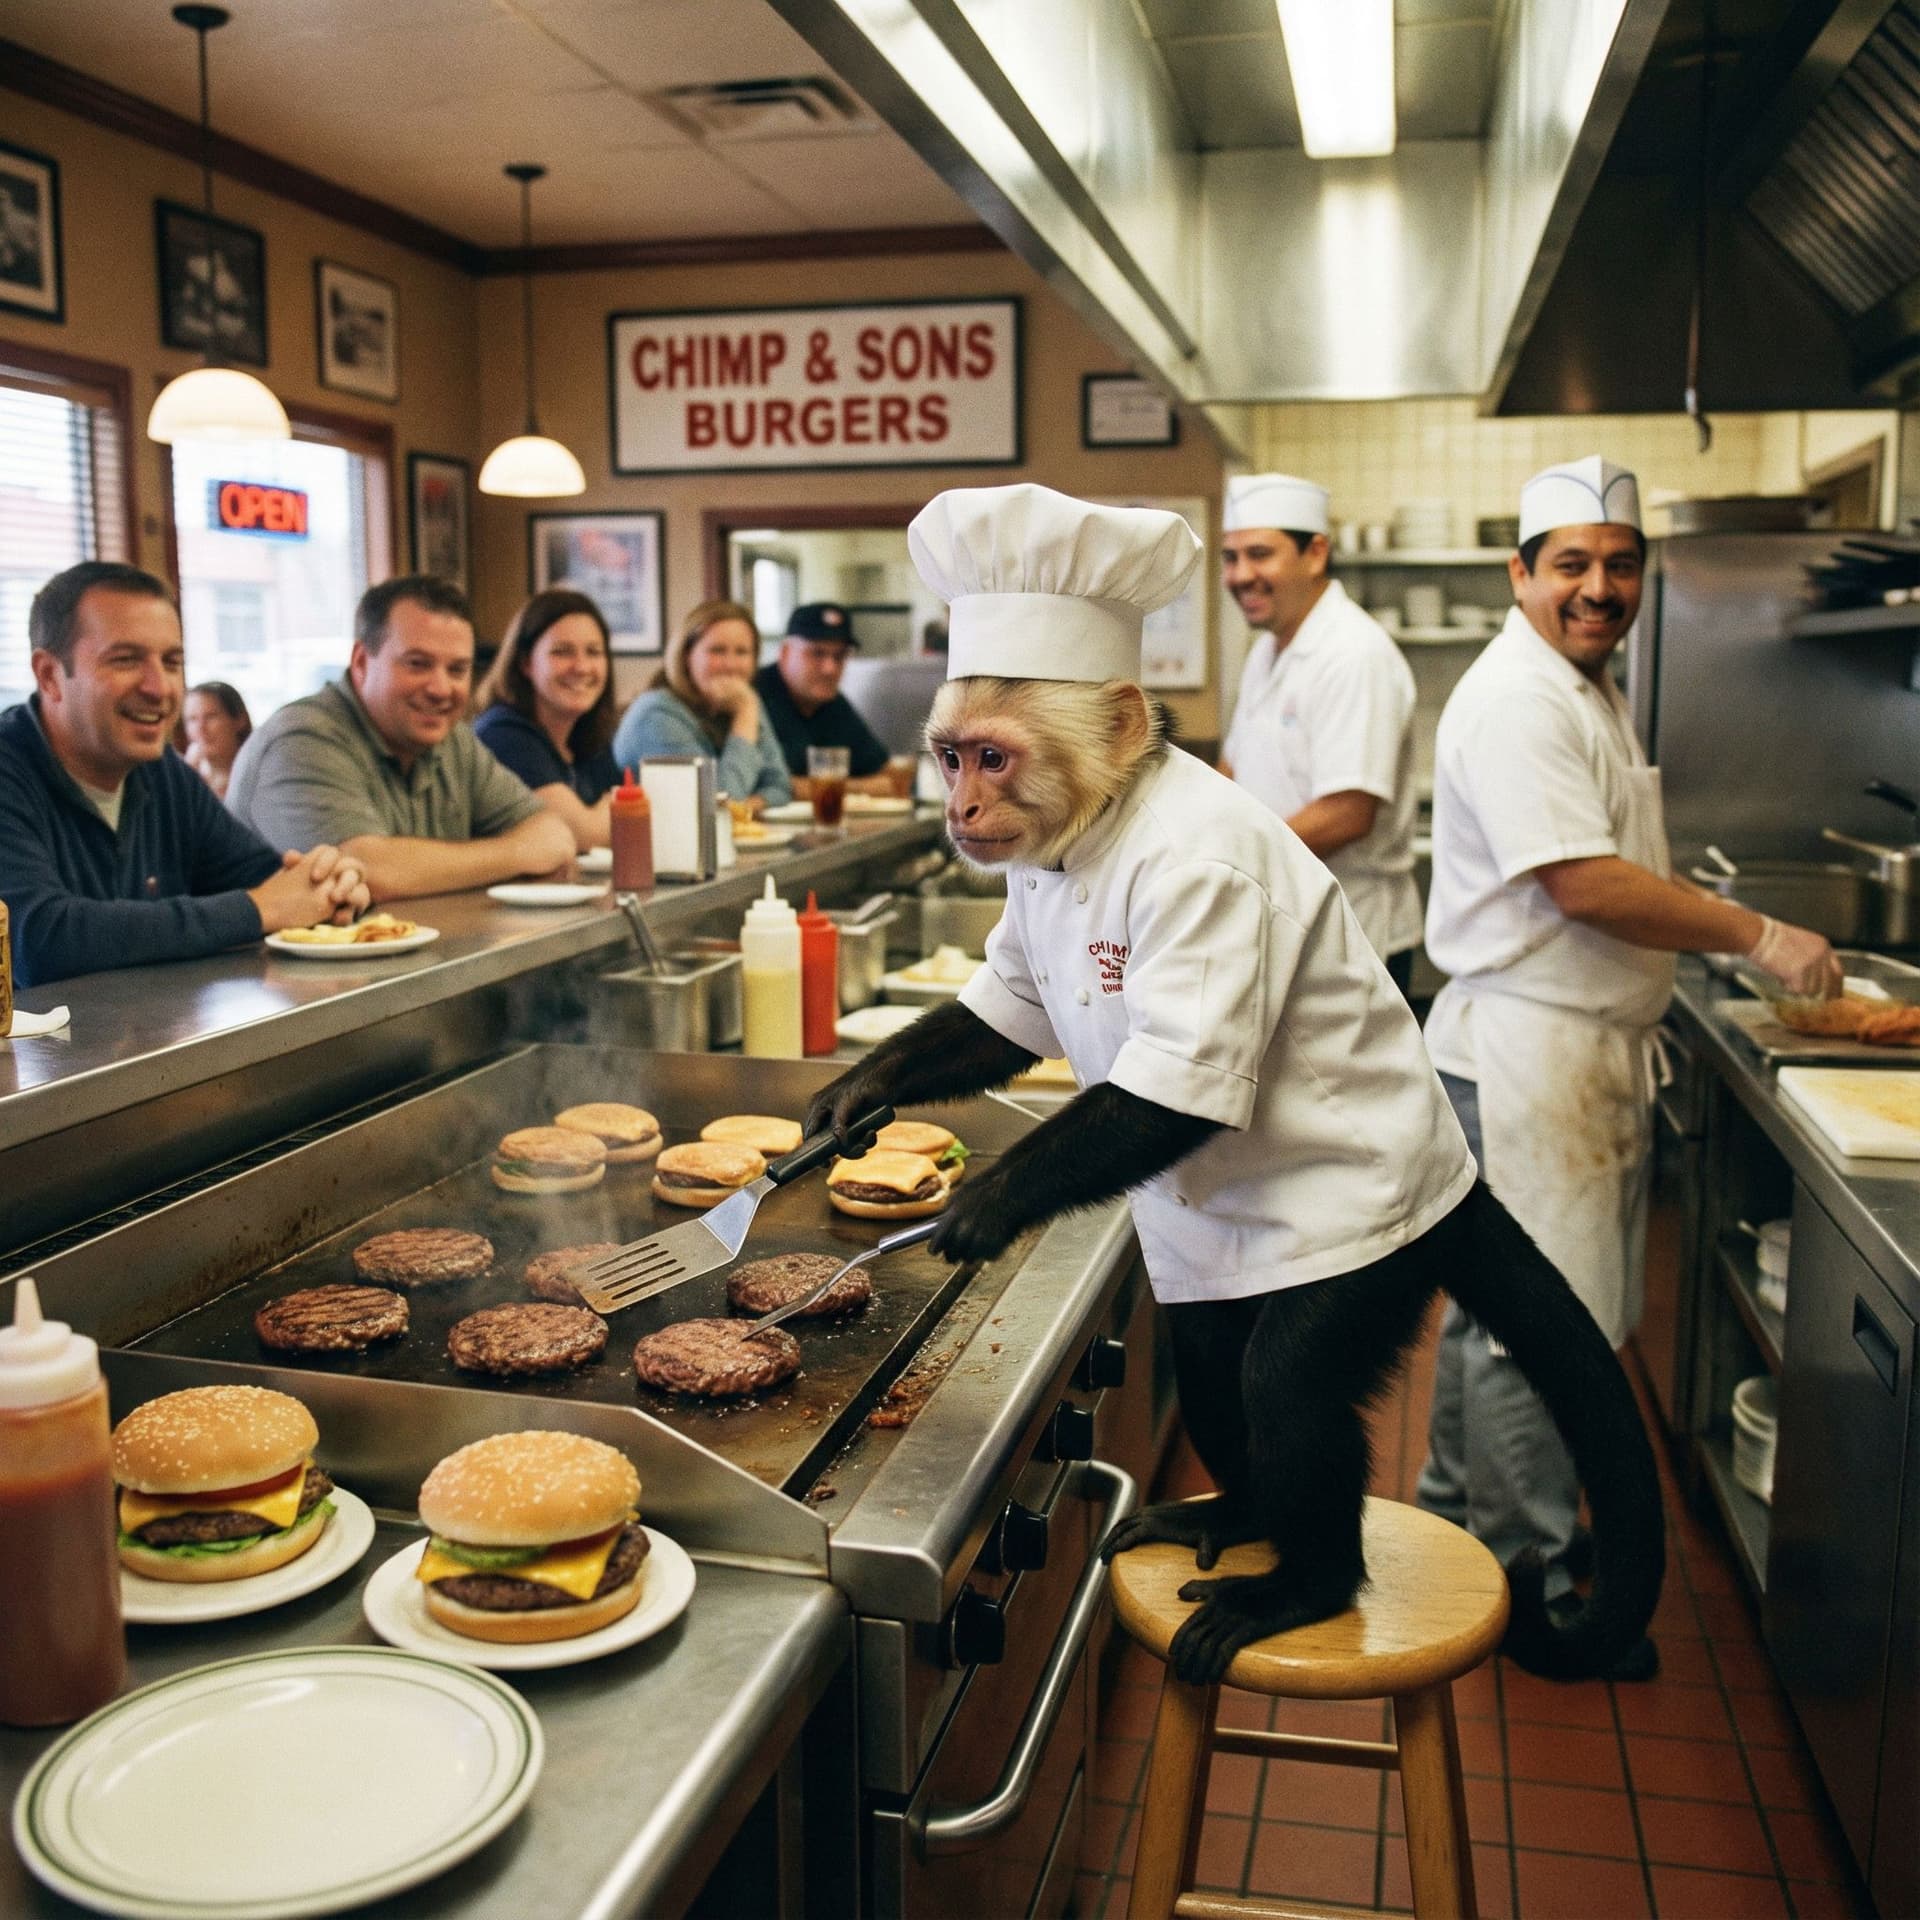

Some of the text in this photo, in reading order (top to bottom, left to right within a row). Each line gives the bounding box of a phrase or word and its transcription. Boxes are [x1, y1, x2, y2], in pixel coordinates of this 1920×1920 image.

[631, 322, 996, 391] CHIMP & SONS
[685, 394, 950, 449] BURGERS
[220, 482, 308, 533] OPEN
